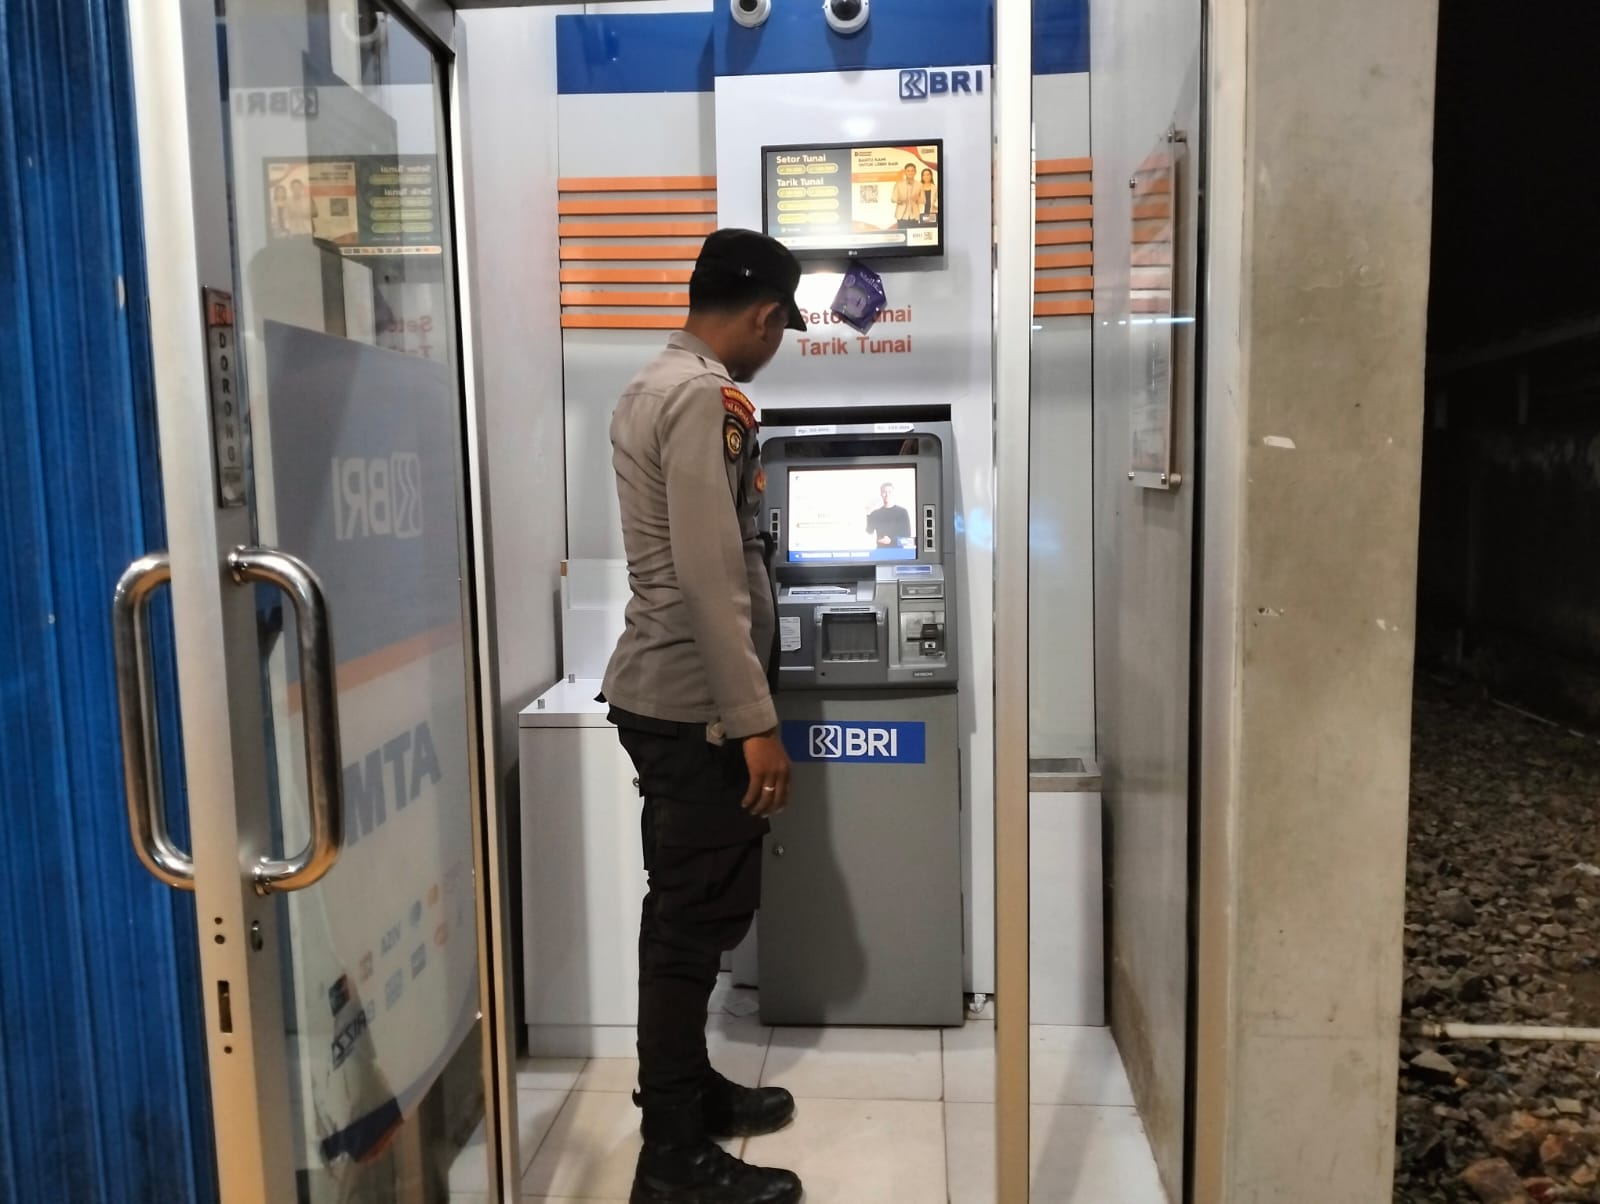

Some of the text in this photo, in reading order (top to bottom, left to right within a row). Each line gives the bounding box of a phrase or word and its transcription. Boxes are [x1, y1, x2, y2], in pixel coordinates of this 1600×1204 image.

[929, 69, 984, 94] BRI
[776, 154, 827, 164] Setor Tunai
[776, 177, 824, 187] Tarik Tunai
[799, 308, 846, 325] Seto
[797, 335, 912, 357] Tarik Tunai
[845, 727, 898, 757] BRI
